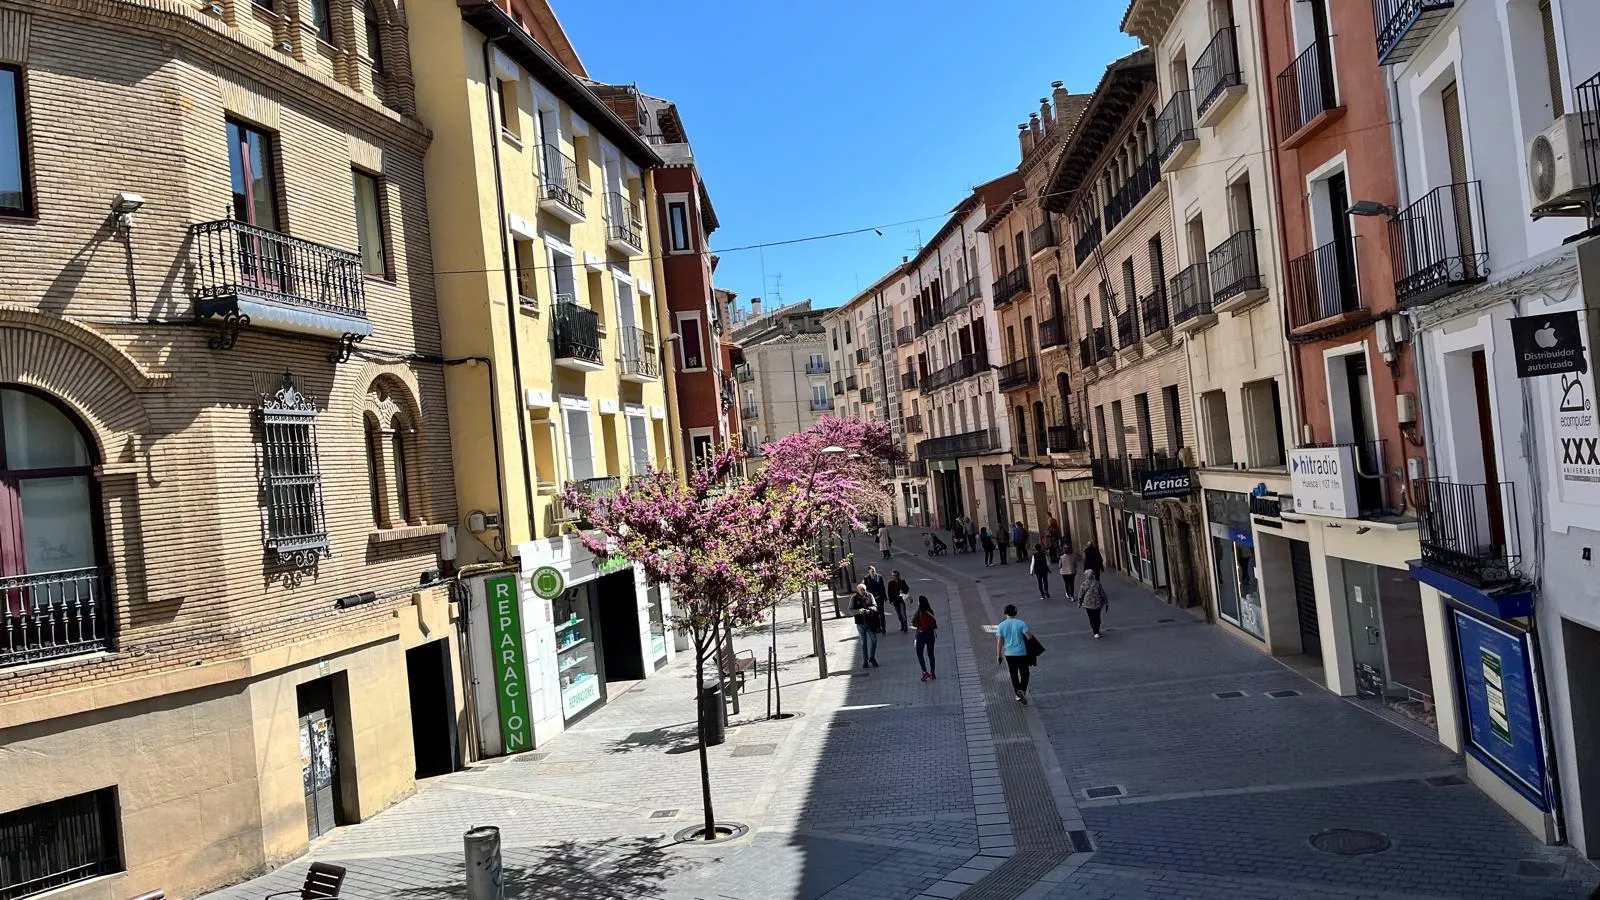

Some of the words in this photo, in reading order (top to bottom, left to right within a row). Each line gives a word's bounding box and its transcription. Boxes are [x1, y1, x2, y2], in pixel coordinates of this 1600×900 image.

[1524, 349, 1575, 360] Distribuidor
[1527, 360, 1573, 371] autorizado
[1560, 415, 1592, 429] ecomputer
[1560, 437, 1600, 466] XXX
[1299, 454, 1338, 475] hitradio
[1144, 478, 1189, 491] Arenas
[496, 583, 524, 748] REPARACION
